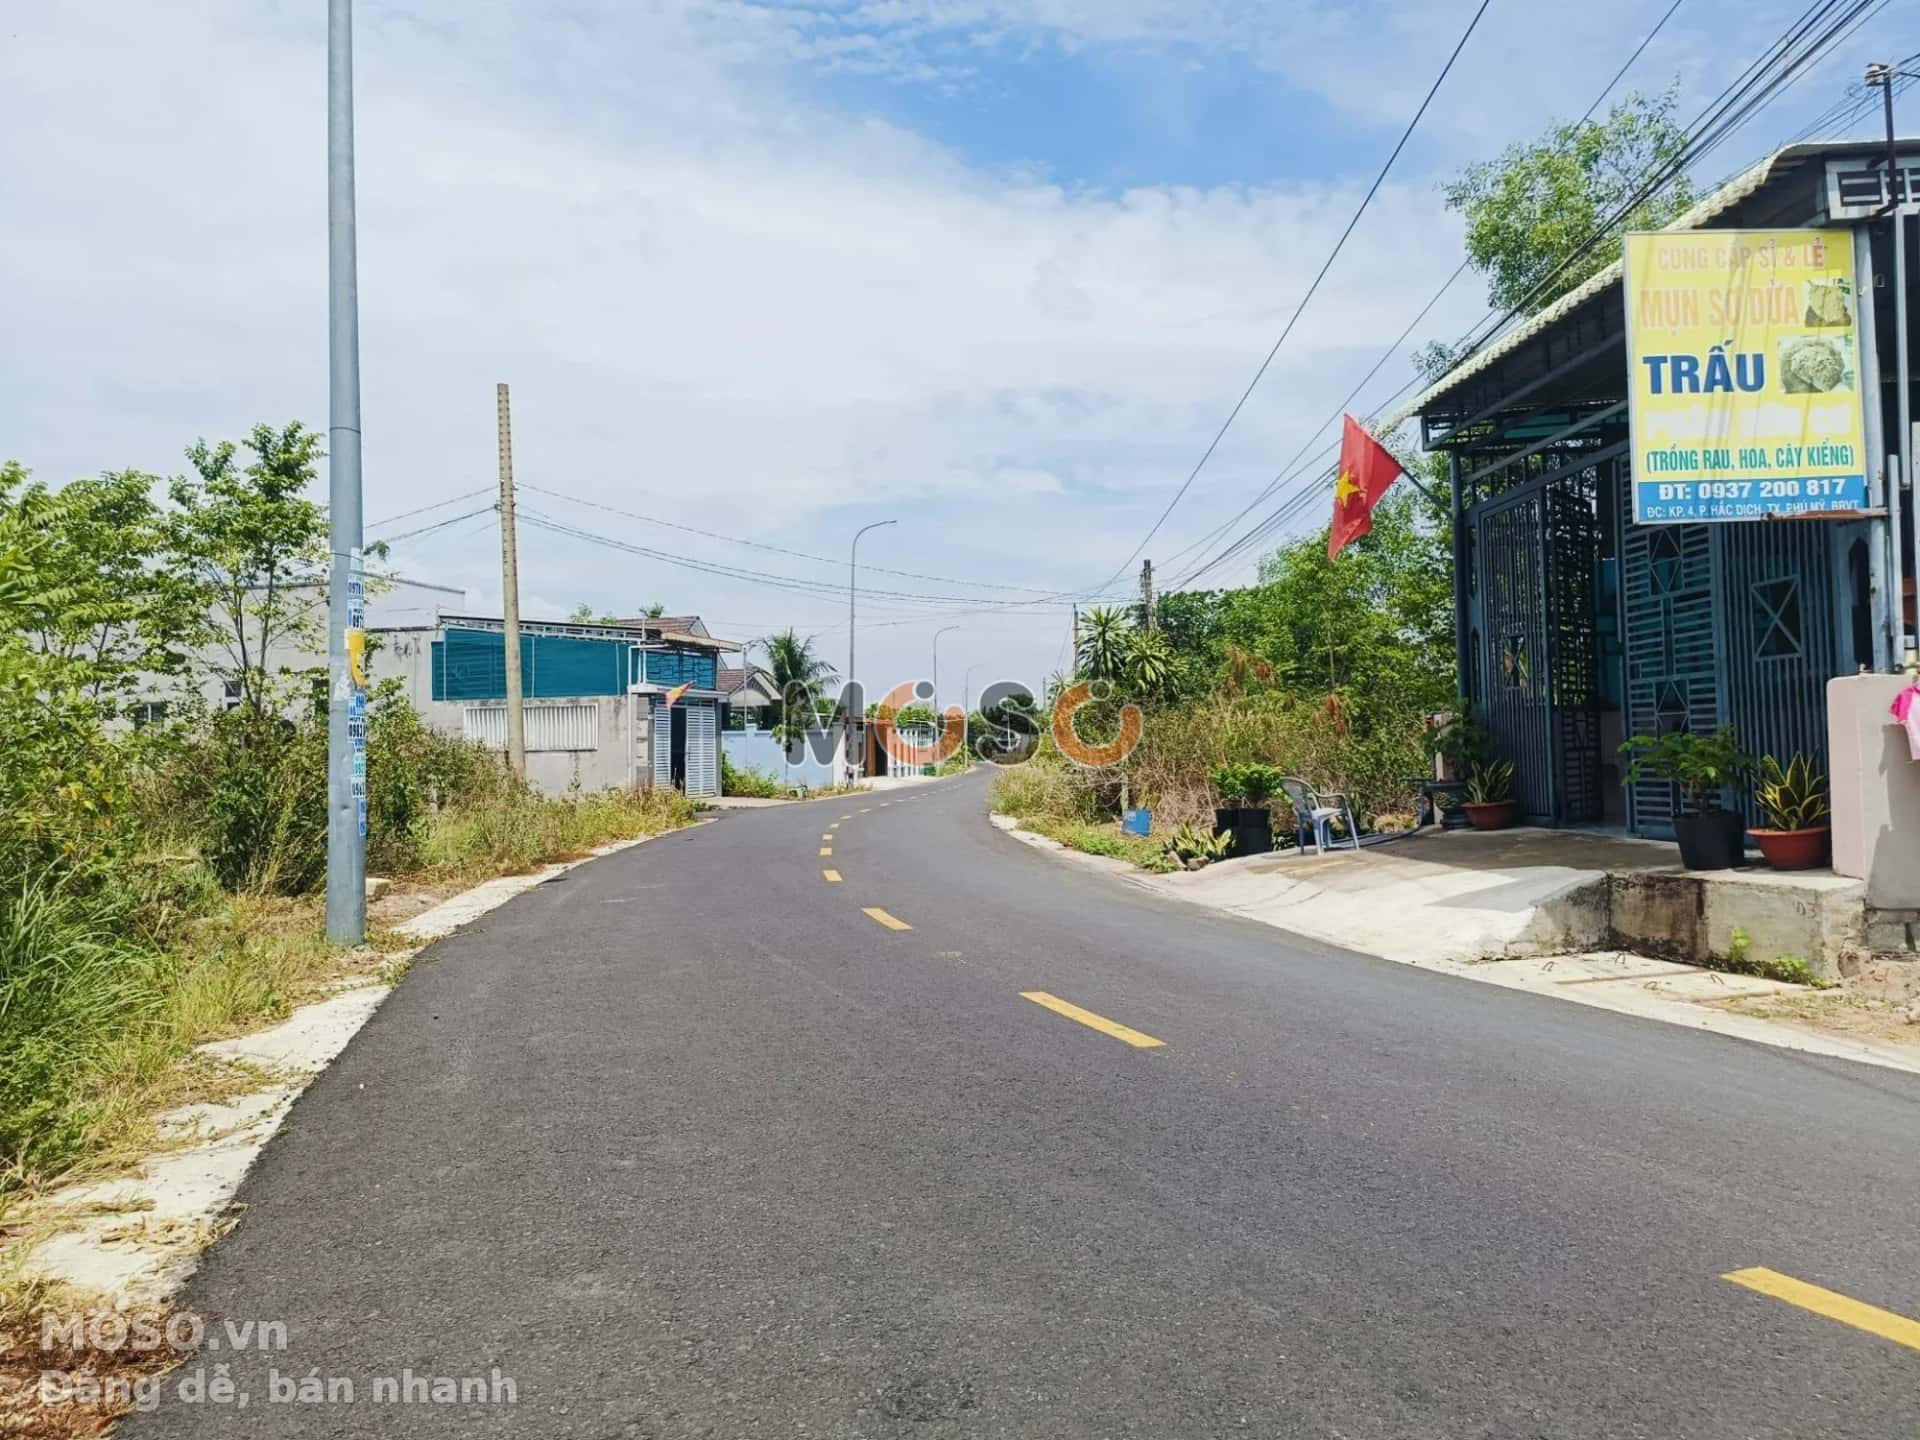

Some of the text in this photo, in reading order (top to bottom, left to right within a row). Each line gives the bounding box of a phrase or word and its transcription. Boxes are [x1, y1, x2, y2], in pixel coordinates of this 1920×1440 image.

[1642, 339, 1765, 394] TRẤU
[1699, 482, 1753, 499] 0937
[1759, 481, 1799, 497] 200
[1806, 479, 1846, 496] 817
